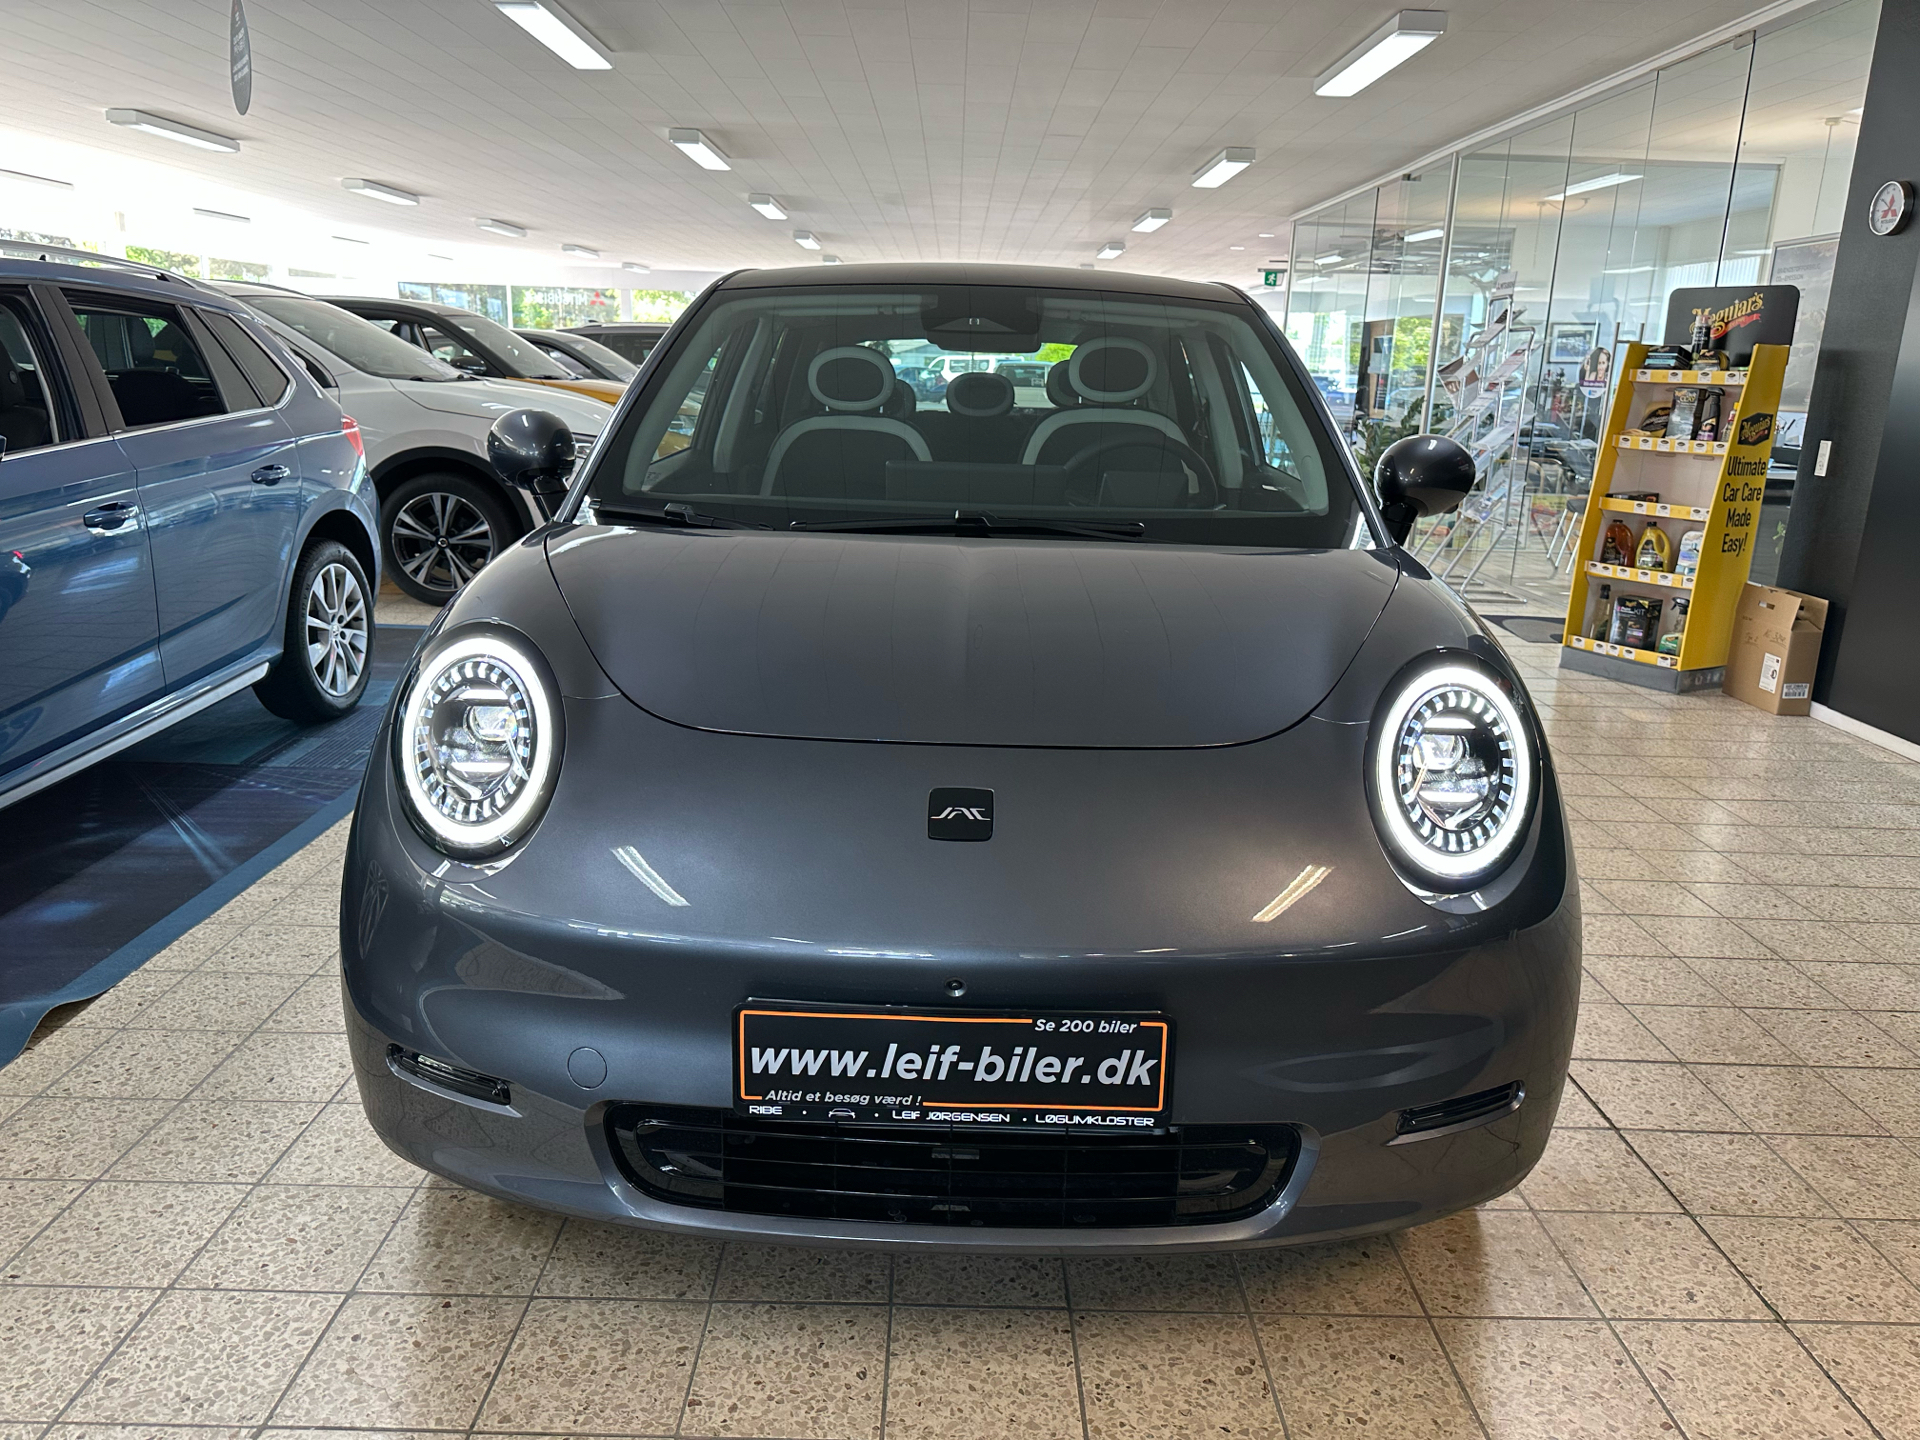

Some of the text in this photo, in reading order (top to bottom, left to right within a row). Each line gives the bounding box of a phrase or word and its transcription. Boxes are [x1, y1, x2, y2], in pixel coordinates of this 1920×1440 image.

[1727, 456, 1766, 476] Ultimate
[1722, 482, 1762, 502] Car Care
[1725, 507, 1751, 528] Made
[1721, 532, 1748, 557] Easy!
[930, 807, 991, 821] JAC
[1034, 1018, 1137, 1034] Se 200 biler
[751, 1043, 1159, 1086] www.leif-biler.dk
[765, 1090, 922, 1106] Altid et besøg værd !
[748, 1105, 1155, 1127] RIBE LEIF JØRGENSEN LØGUMKLOSTER
